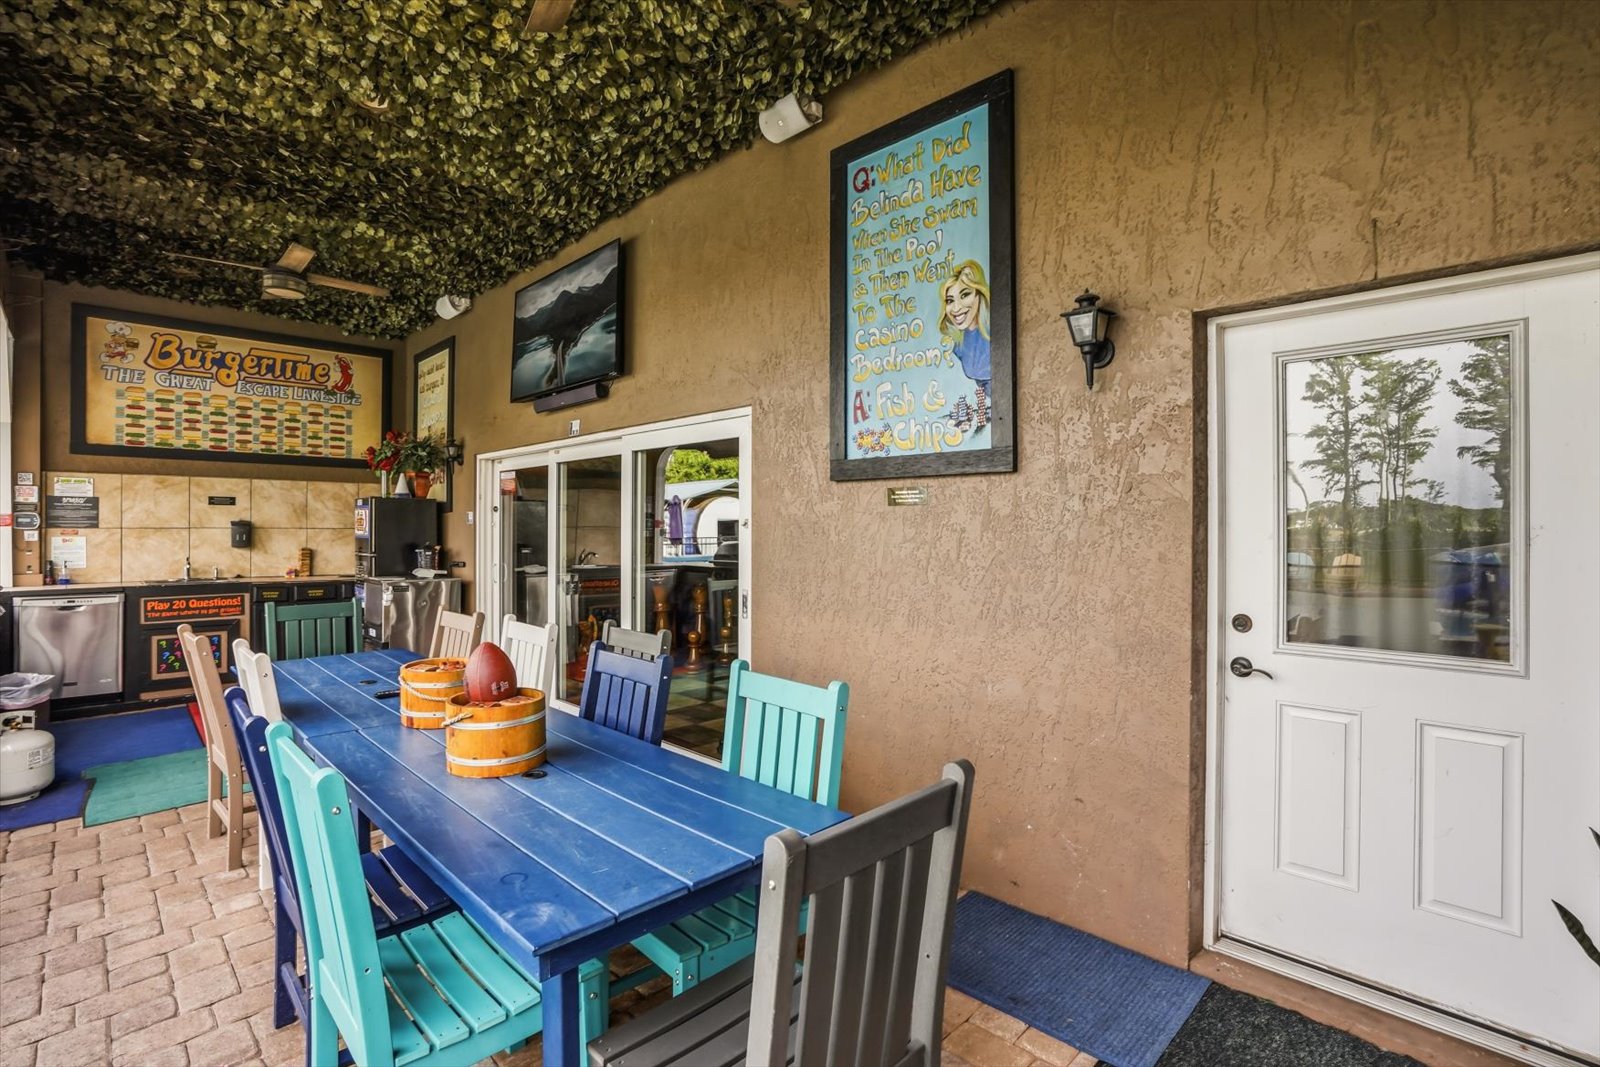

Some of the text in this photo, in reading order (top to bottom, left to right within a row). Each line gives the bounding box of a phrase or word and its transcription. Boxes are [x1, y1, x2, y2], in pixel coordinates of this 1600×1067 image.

[852, 121, 972, 193] Q: What Did
[851, 164, 981, 227] Belinda Have
[889, 214, 920, 242] She
[922, 196, 978, 228] Swam
[852, 229, 944, 275] In The Pool
[868, 269, 910, 295] Then
[912, 248, 956, 283] Went
[852, 293, 917, 326] To The
[101, 364, 145, 384] THE
[154, 371, 215, 391] GREAT
[235, 379, 289, 399] ESCAPE
[853, 389, 872, 425] A:
[875, 381, 915, 420] Fish
[892, 415, 965, 454] Chips
[147, 597, 241, 611] Play 20 Questions!
